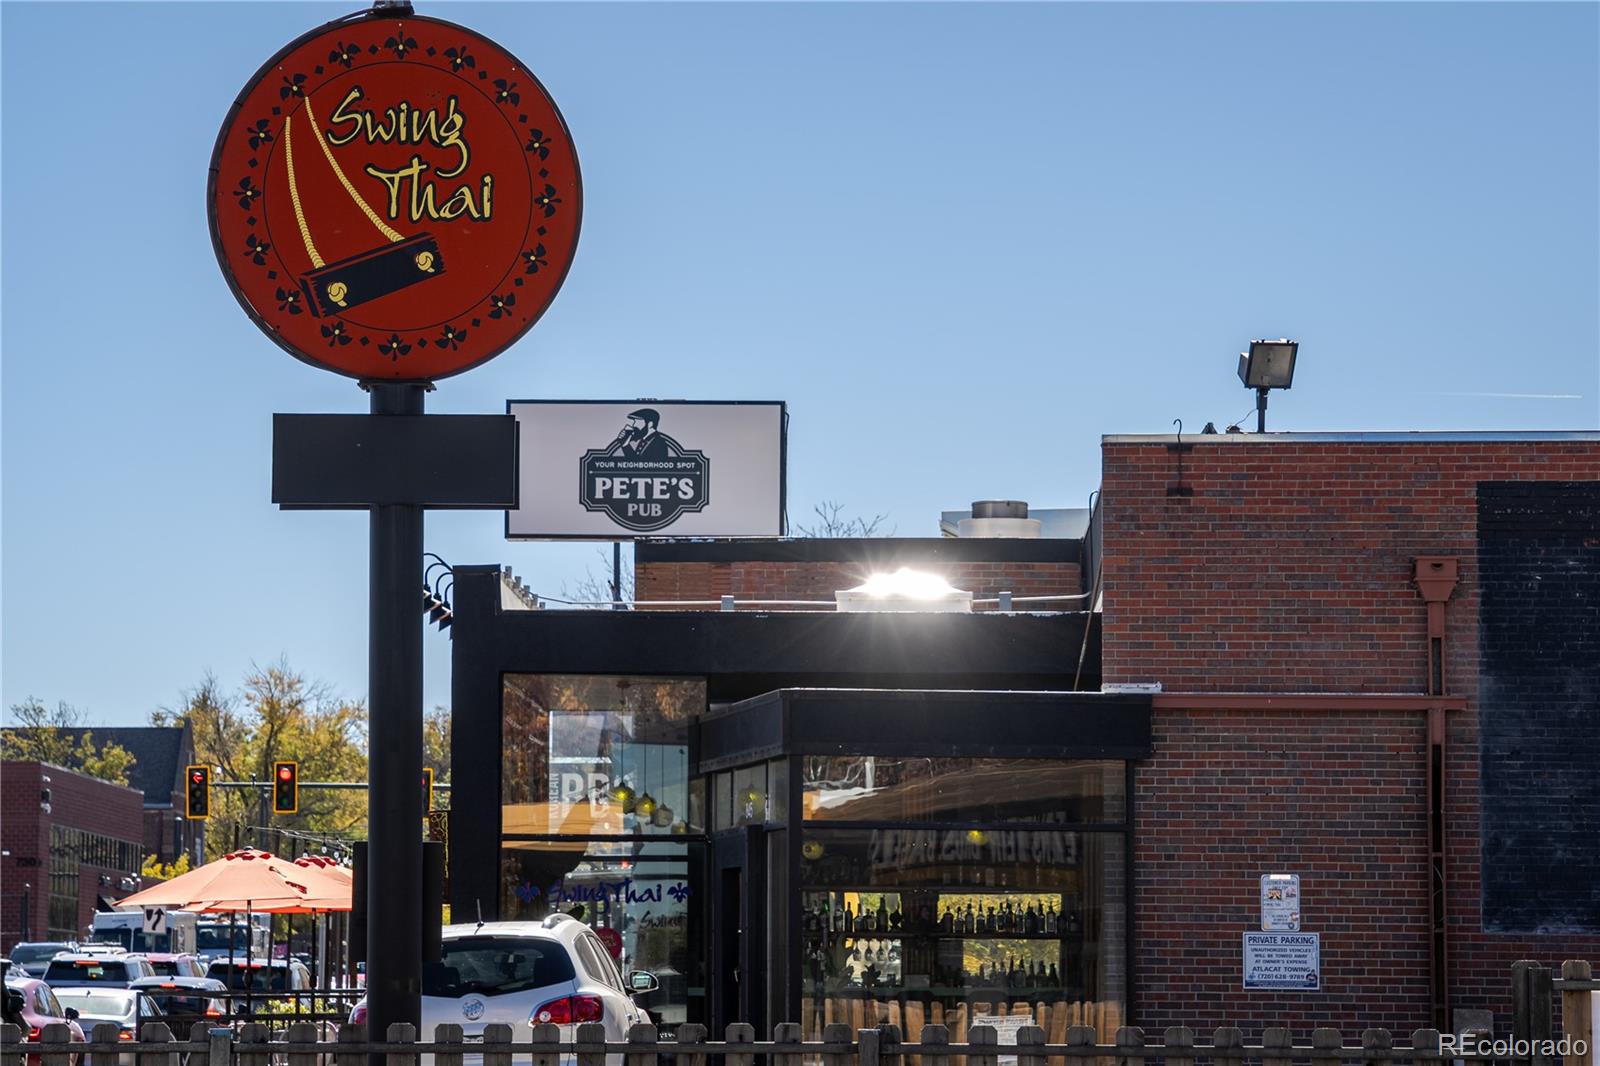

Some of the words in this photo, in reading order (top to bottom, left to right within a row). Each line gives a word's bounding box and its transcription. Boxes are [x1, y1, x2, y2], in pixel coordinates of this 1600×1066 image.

[327, 87, 469, 178] Swing
[366, 156, 494, 222] Thai
[595, 461, 615, 469] YOUR
[617, 461, 674, 469] NEIGHBORHOOD
[594, 477, 695, 500] PETE'S
[627, 503, 662, 516] PUB
[608, 877, 662, 904] Thai
[1248, 936, 1278, 944] PRIVATE
[1281, 936, 1314, 944] PARKING
